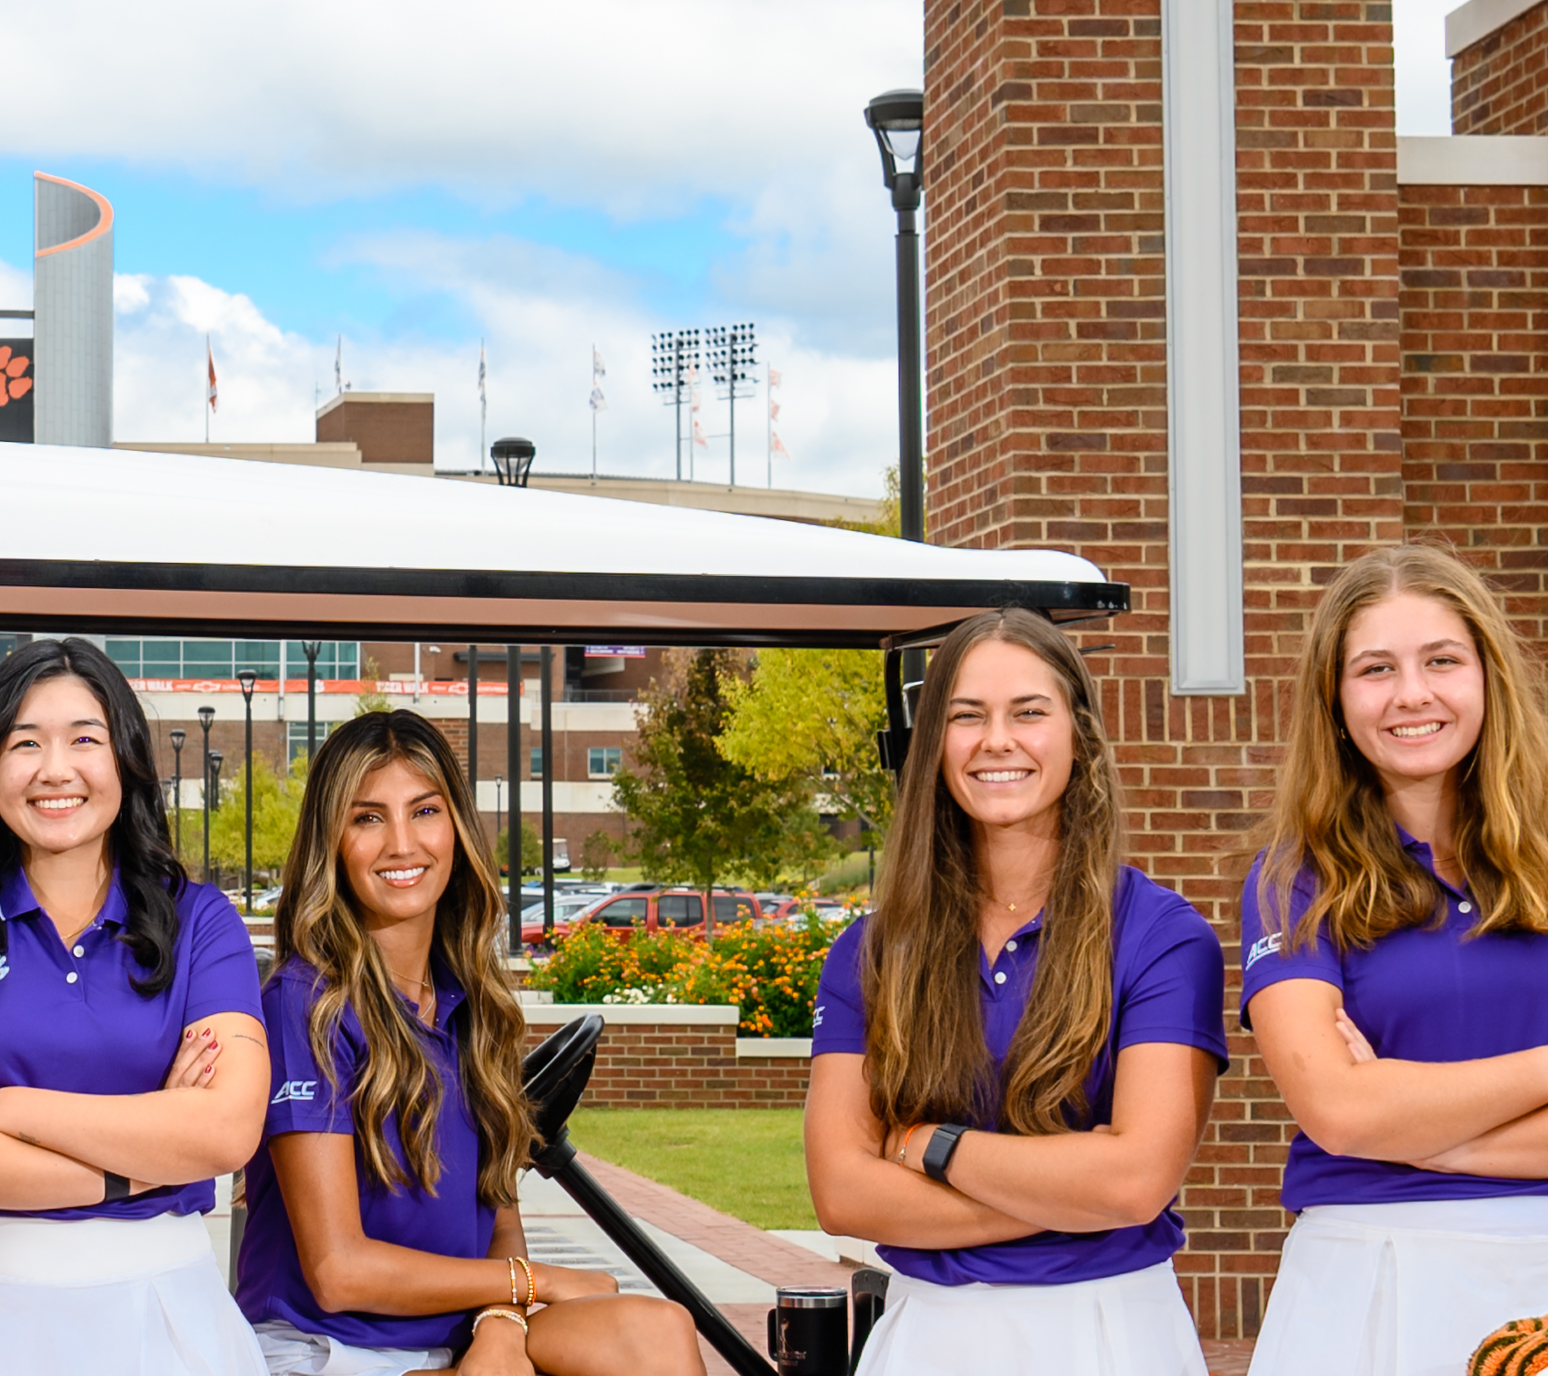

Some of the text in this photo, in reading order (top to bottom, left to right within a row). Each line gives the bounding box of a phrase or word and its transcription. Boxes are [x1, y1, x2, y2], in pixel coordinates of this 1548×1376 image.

[147, 680, 174, 692] WALK
[1246, 932, 1283, 965] ACC
[273, 1080, 317, 1100] ACC
